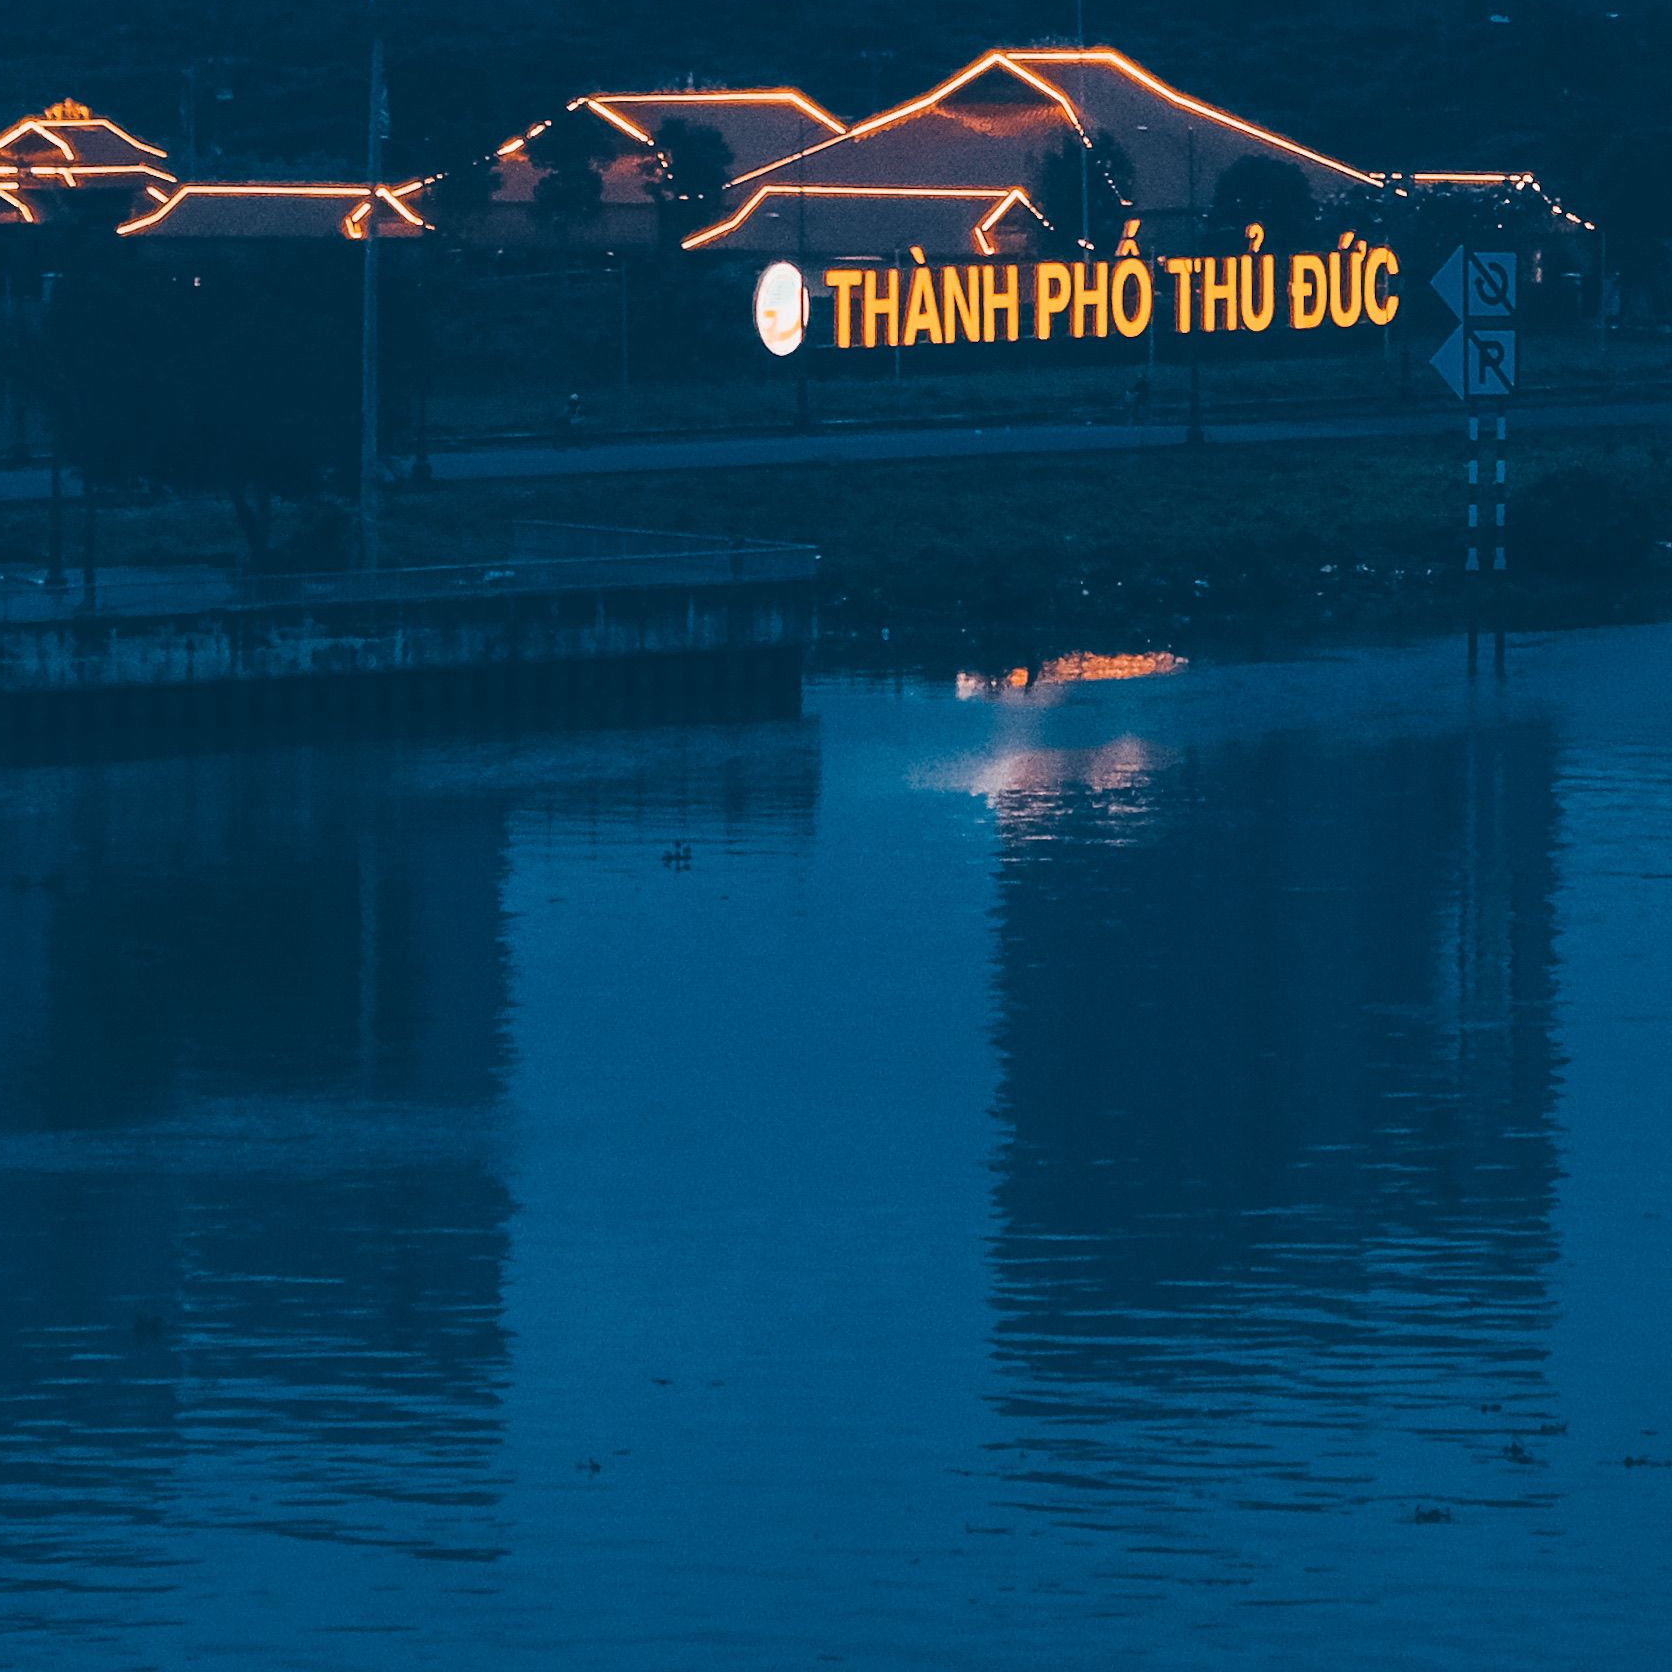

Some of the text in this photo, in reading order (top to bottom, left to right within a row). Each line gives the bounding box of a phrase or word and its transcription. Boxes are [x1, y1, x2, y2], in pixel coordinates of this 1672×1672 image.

[825, 218, 1399, 348] THÀNH PHỐ THỦ ĐỨC
